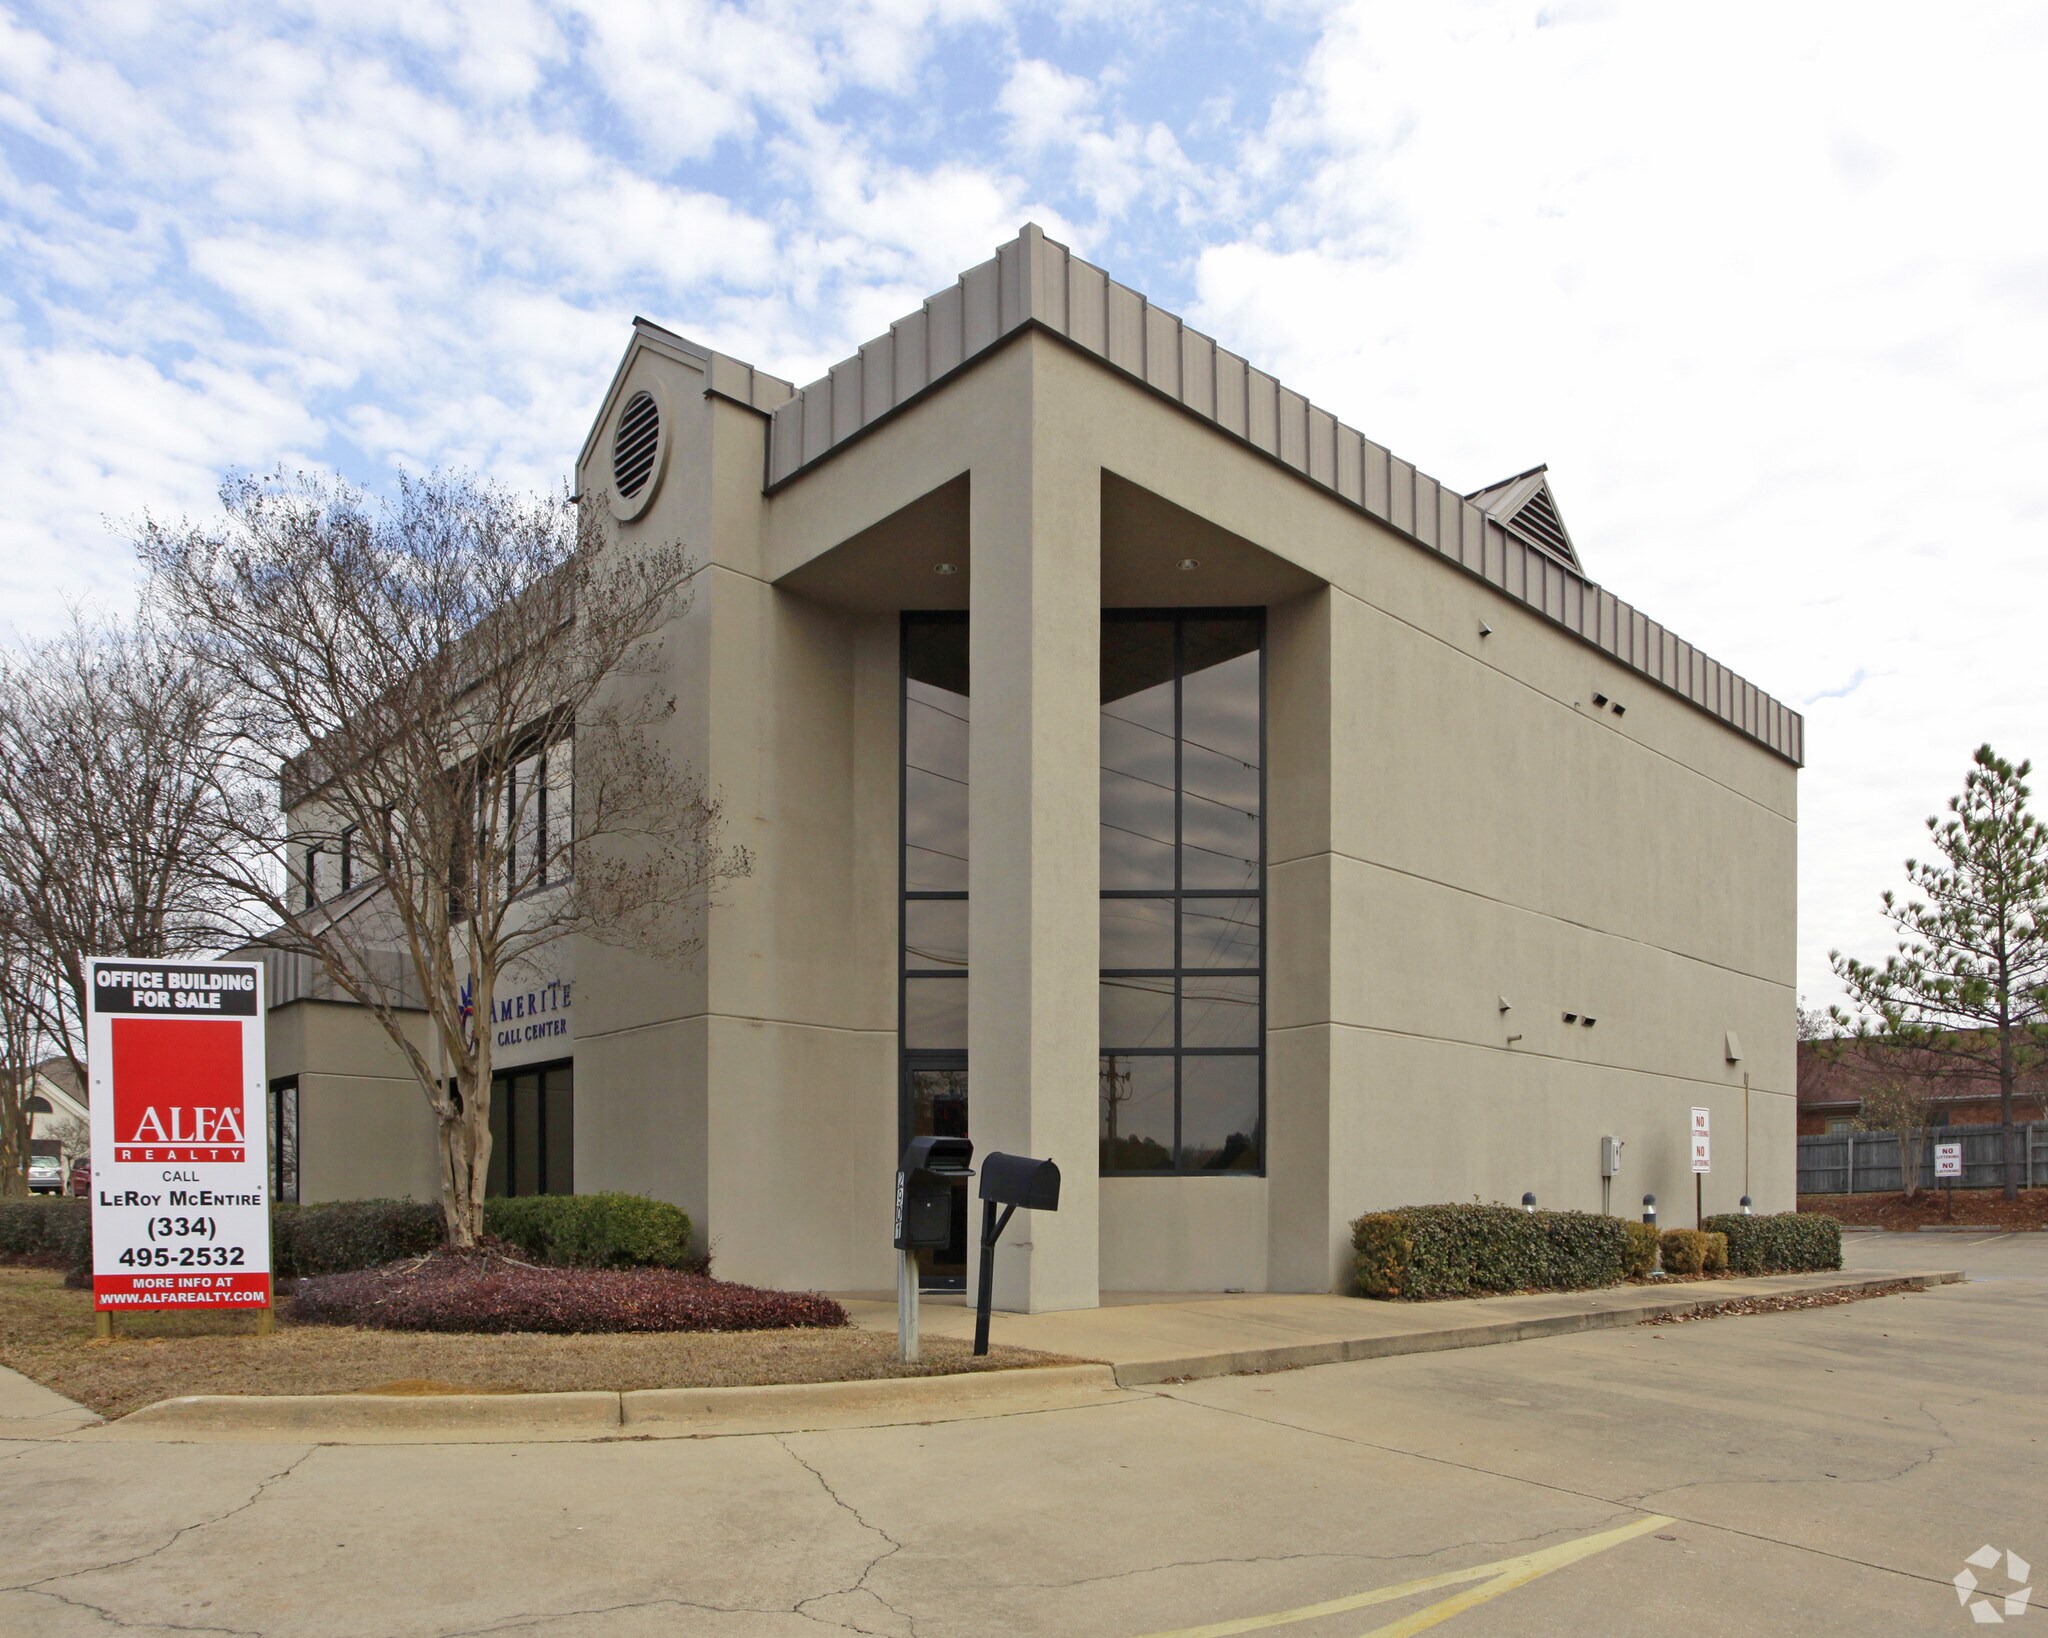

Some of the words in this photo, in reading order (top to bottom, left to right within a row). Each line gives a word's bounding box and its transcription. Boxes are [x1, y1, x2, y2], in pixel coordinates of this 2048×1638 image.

[97, 970, 163, 989] OFFICE
[168, 971, 254, 991] BUILDING
[133, 990, 171, 1008] FOR
[175, 991, 221, 1009] SALE
[498, 1028, 522, 1046] CALL
[525, 1019, 567, 1042] CENTER
[1696, 1116, 1704, 1127] NO
[122, 1149, 241, 1161] REALTY
[1696, 1146, 1704, 1156] NO
[162, 1171, 200, 1182] CALL
[147, 1217, 217, 1241] (334)
[119, 1247, 245, 1267] 495-2532
[133, 1278, 175, 1288] MORE
[178, 1278, 212, 1288] INFO
[215, 1277, 233, 1287] AT
[100, 1291, 264, 1304] WWW.ALFAREALTY.COM
